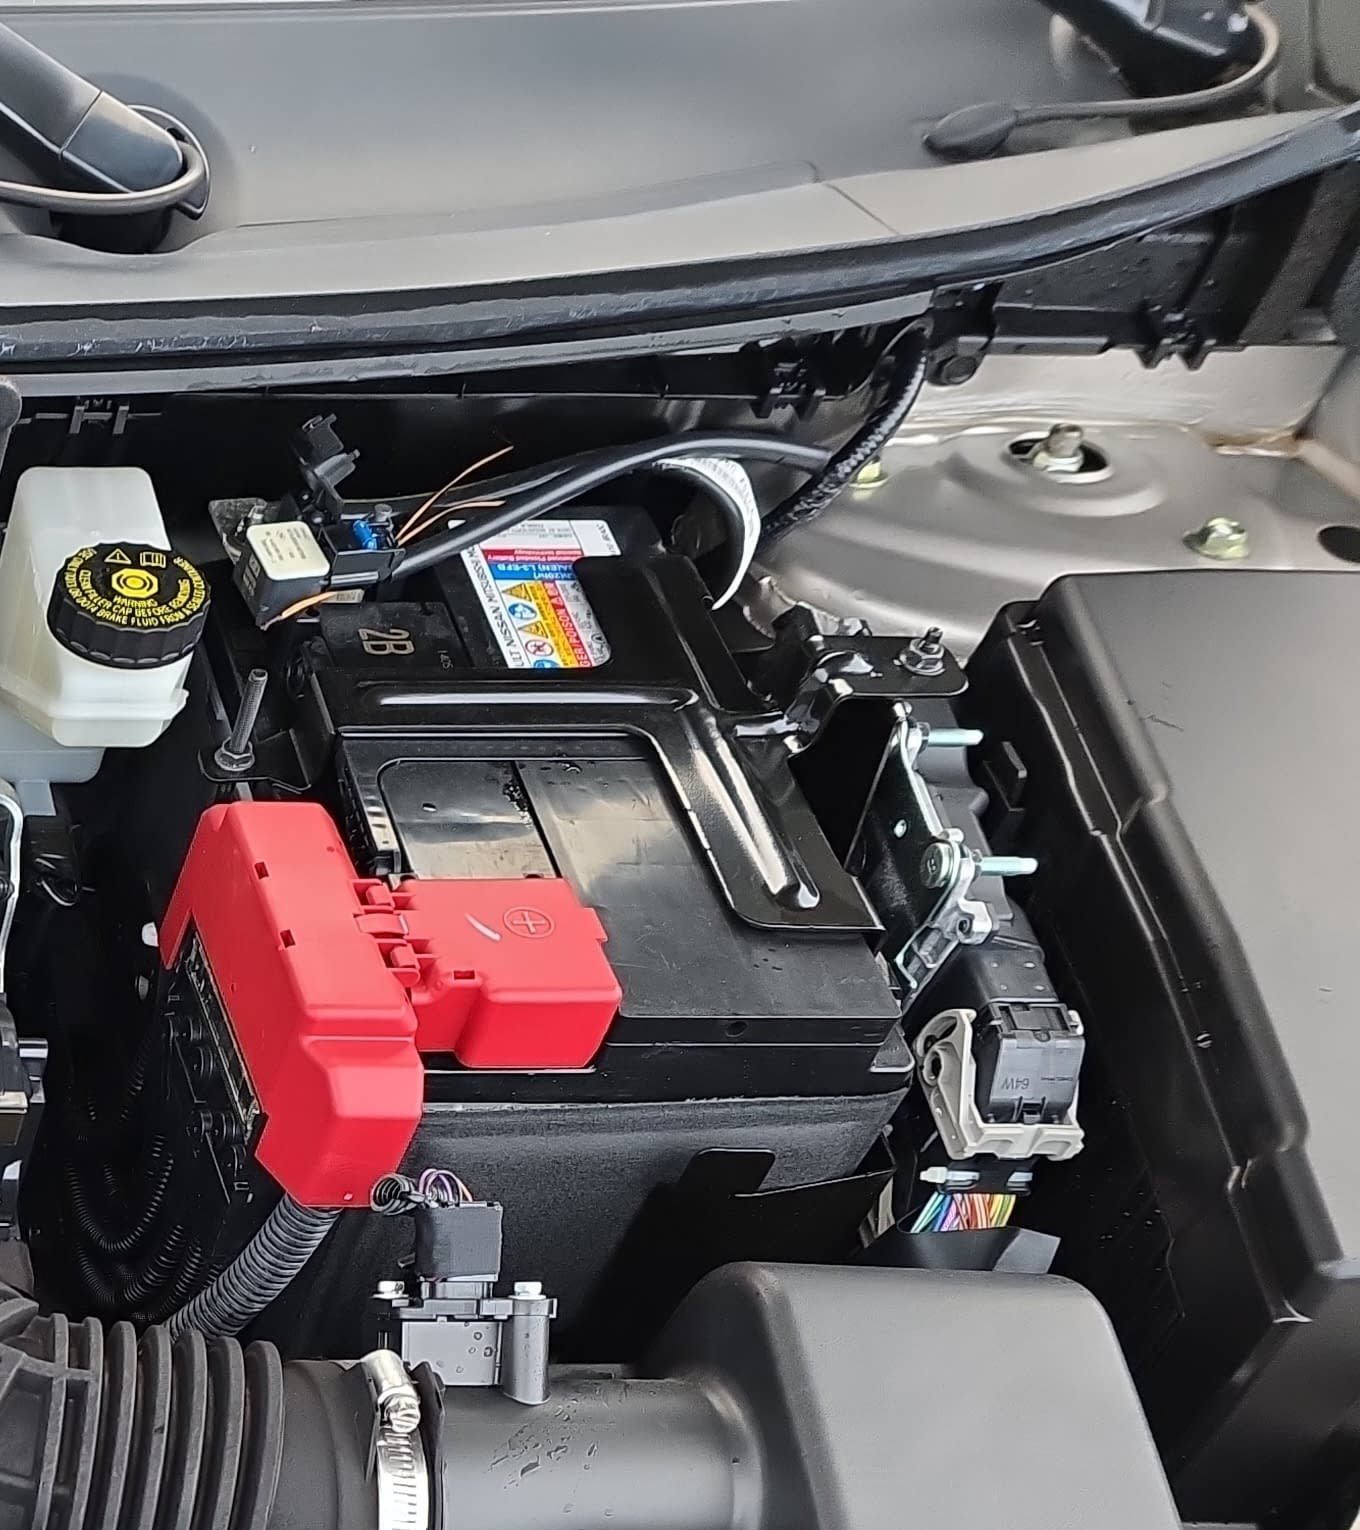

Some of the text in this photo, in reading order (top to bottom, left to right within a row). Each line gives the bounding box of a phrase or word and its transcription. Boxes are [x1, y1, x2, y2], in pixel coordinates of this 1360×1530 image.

[95, 608, 128, 625] BRAKE
[130, 616, 159, 626] FLUID
[112, 604, 132, 616] CAP
[134, 603, 173, 617] BEFORE
[490, 604, 517, 648] NISSAN
[358, 628, 415, 655] 2B
[1001, 1077, 1030, 1090] 64W
